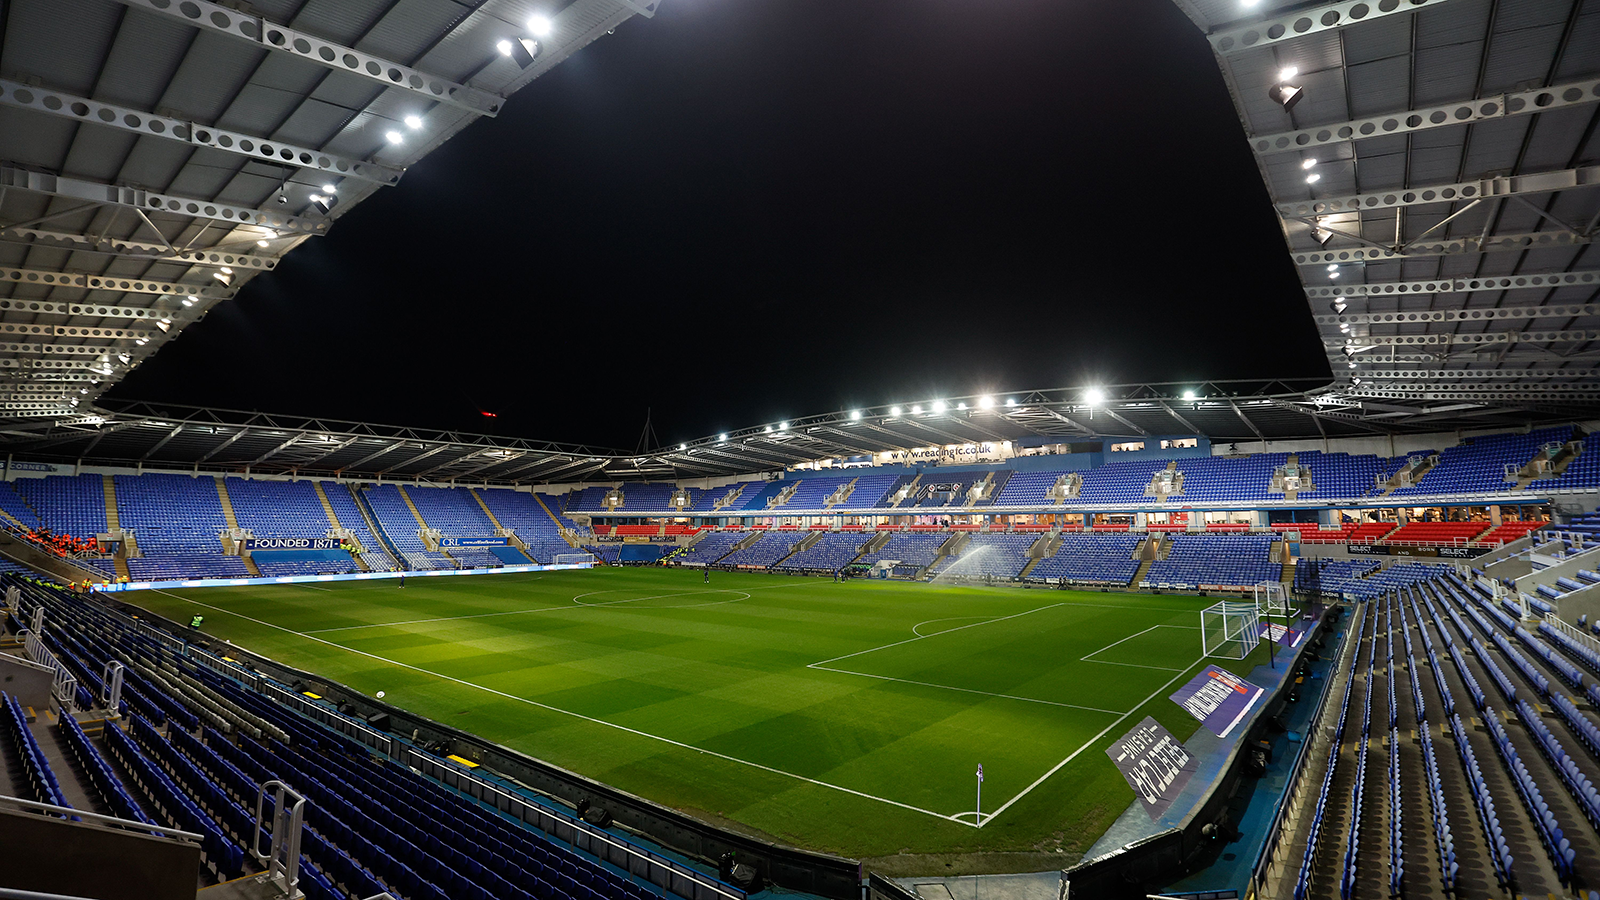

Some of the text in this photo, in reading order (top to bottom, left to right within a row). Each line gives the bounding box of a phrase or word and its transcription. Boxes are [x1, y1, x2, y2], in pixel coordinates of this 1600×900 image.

[254, 539, 333, 549] FOUNDED 1871
[1121, 726, 1157, 760] LEASING
